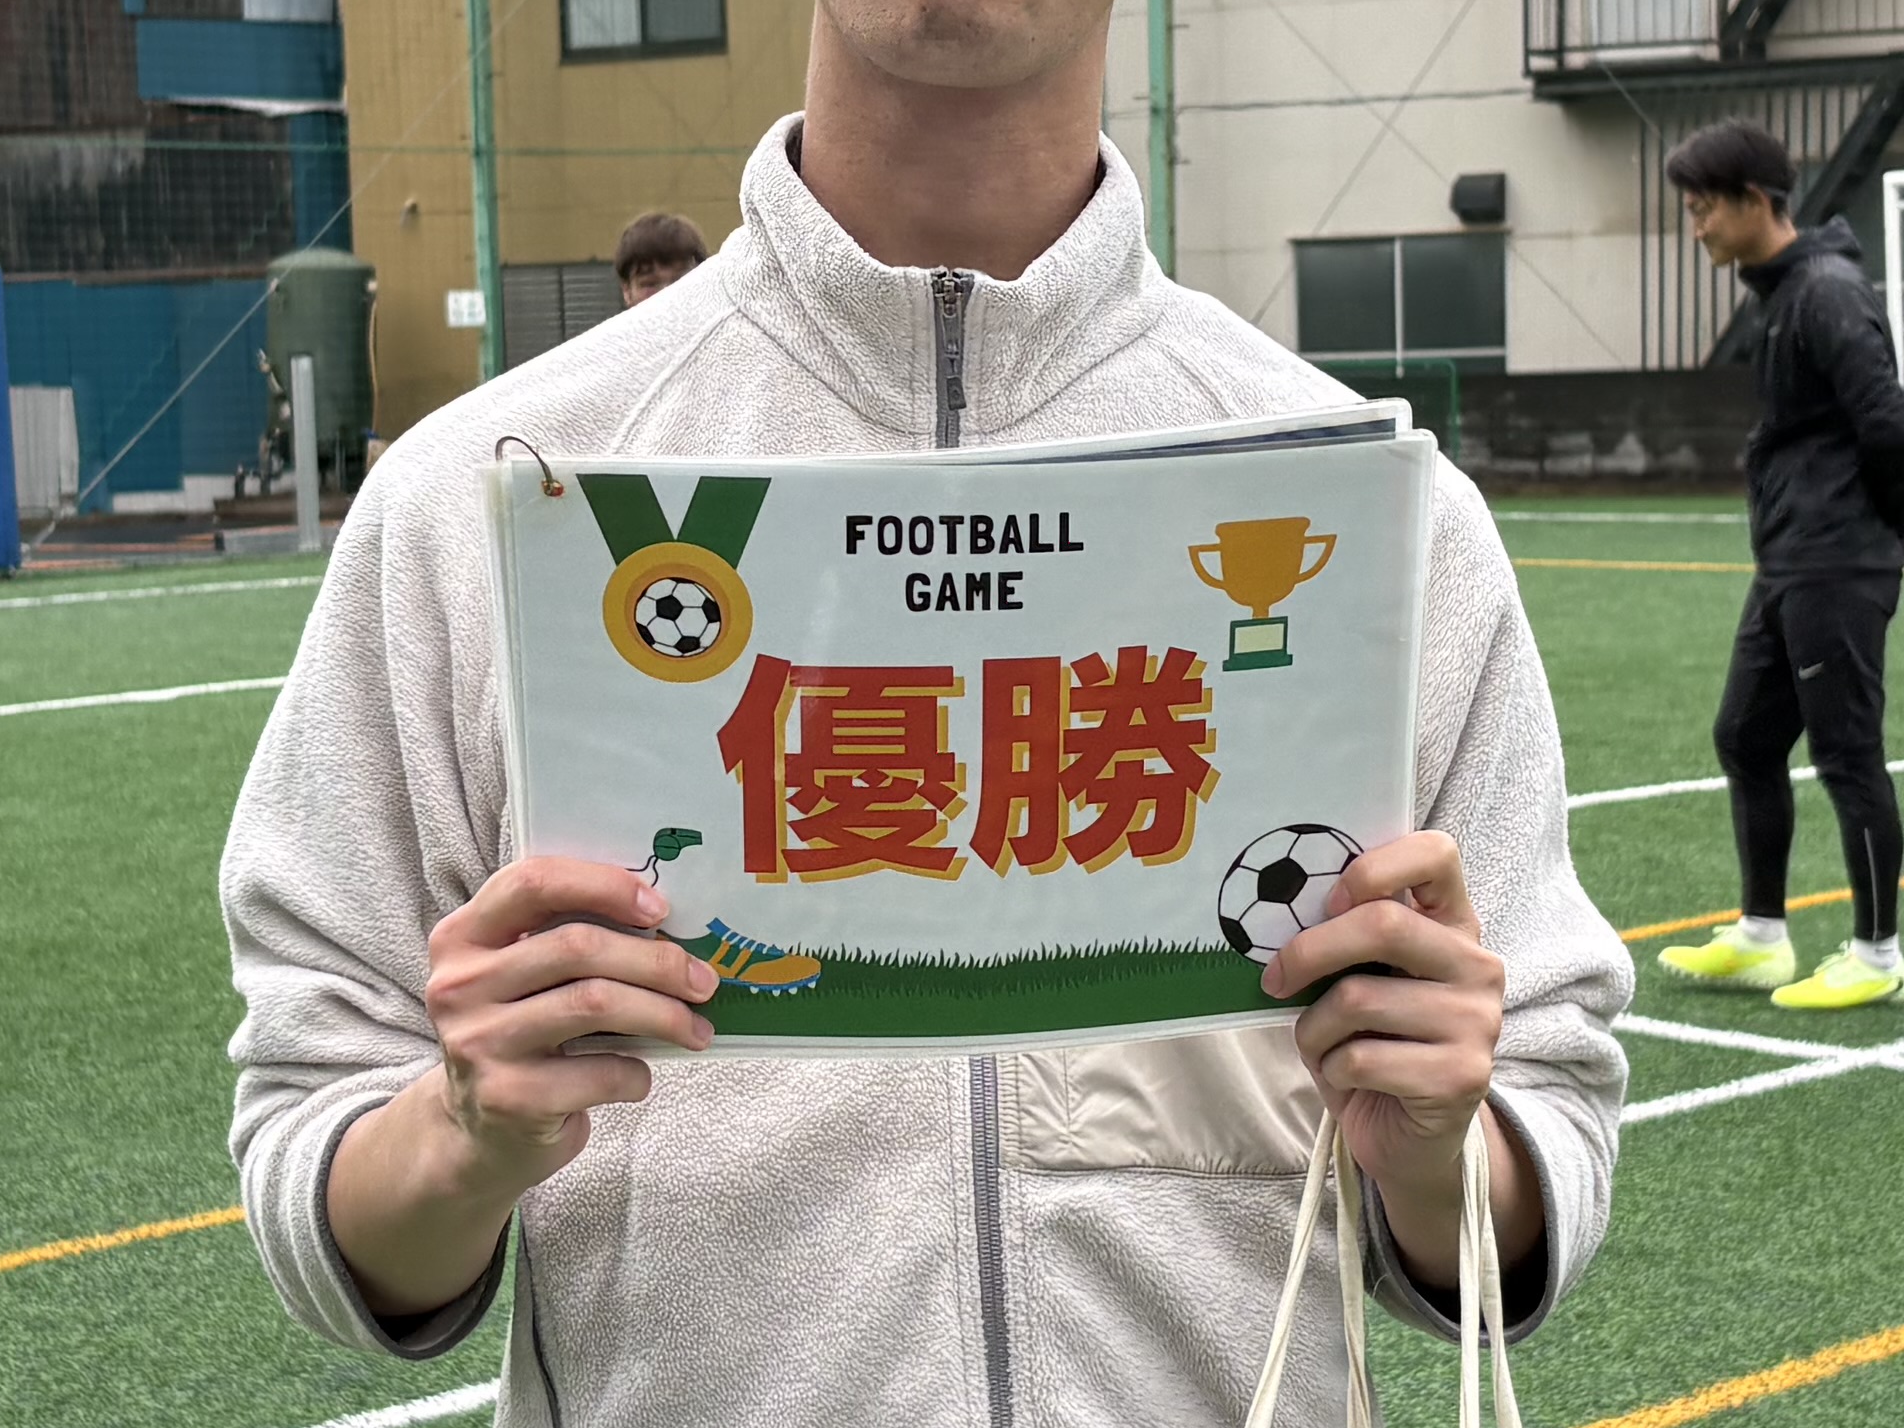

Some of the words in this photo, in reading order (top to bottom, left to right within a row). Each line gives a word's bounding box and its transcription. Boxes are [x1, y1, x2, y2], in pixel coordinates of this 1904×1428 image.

[845, 512, 1084, 555] FOOTBALL
[904, 571, 1024, 612] GAME
[717, 646, 1221, 883] 優勝
